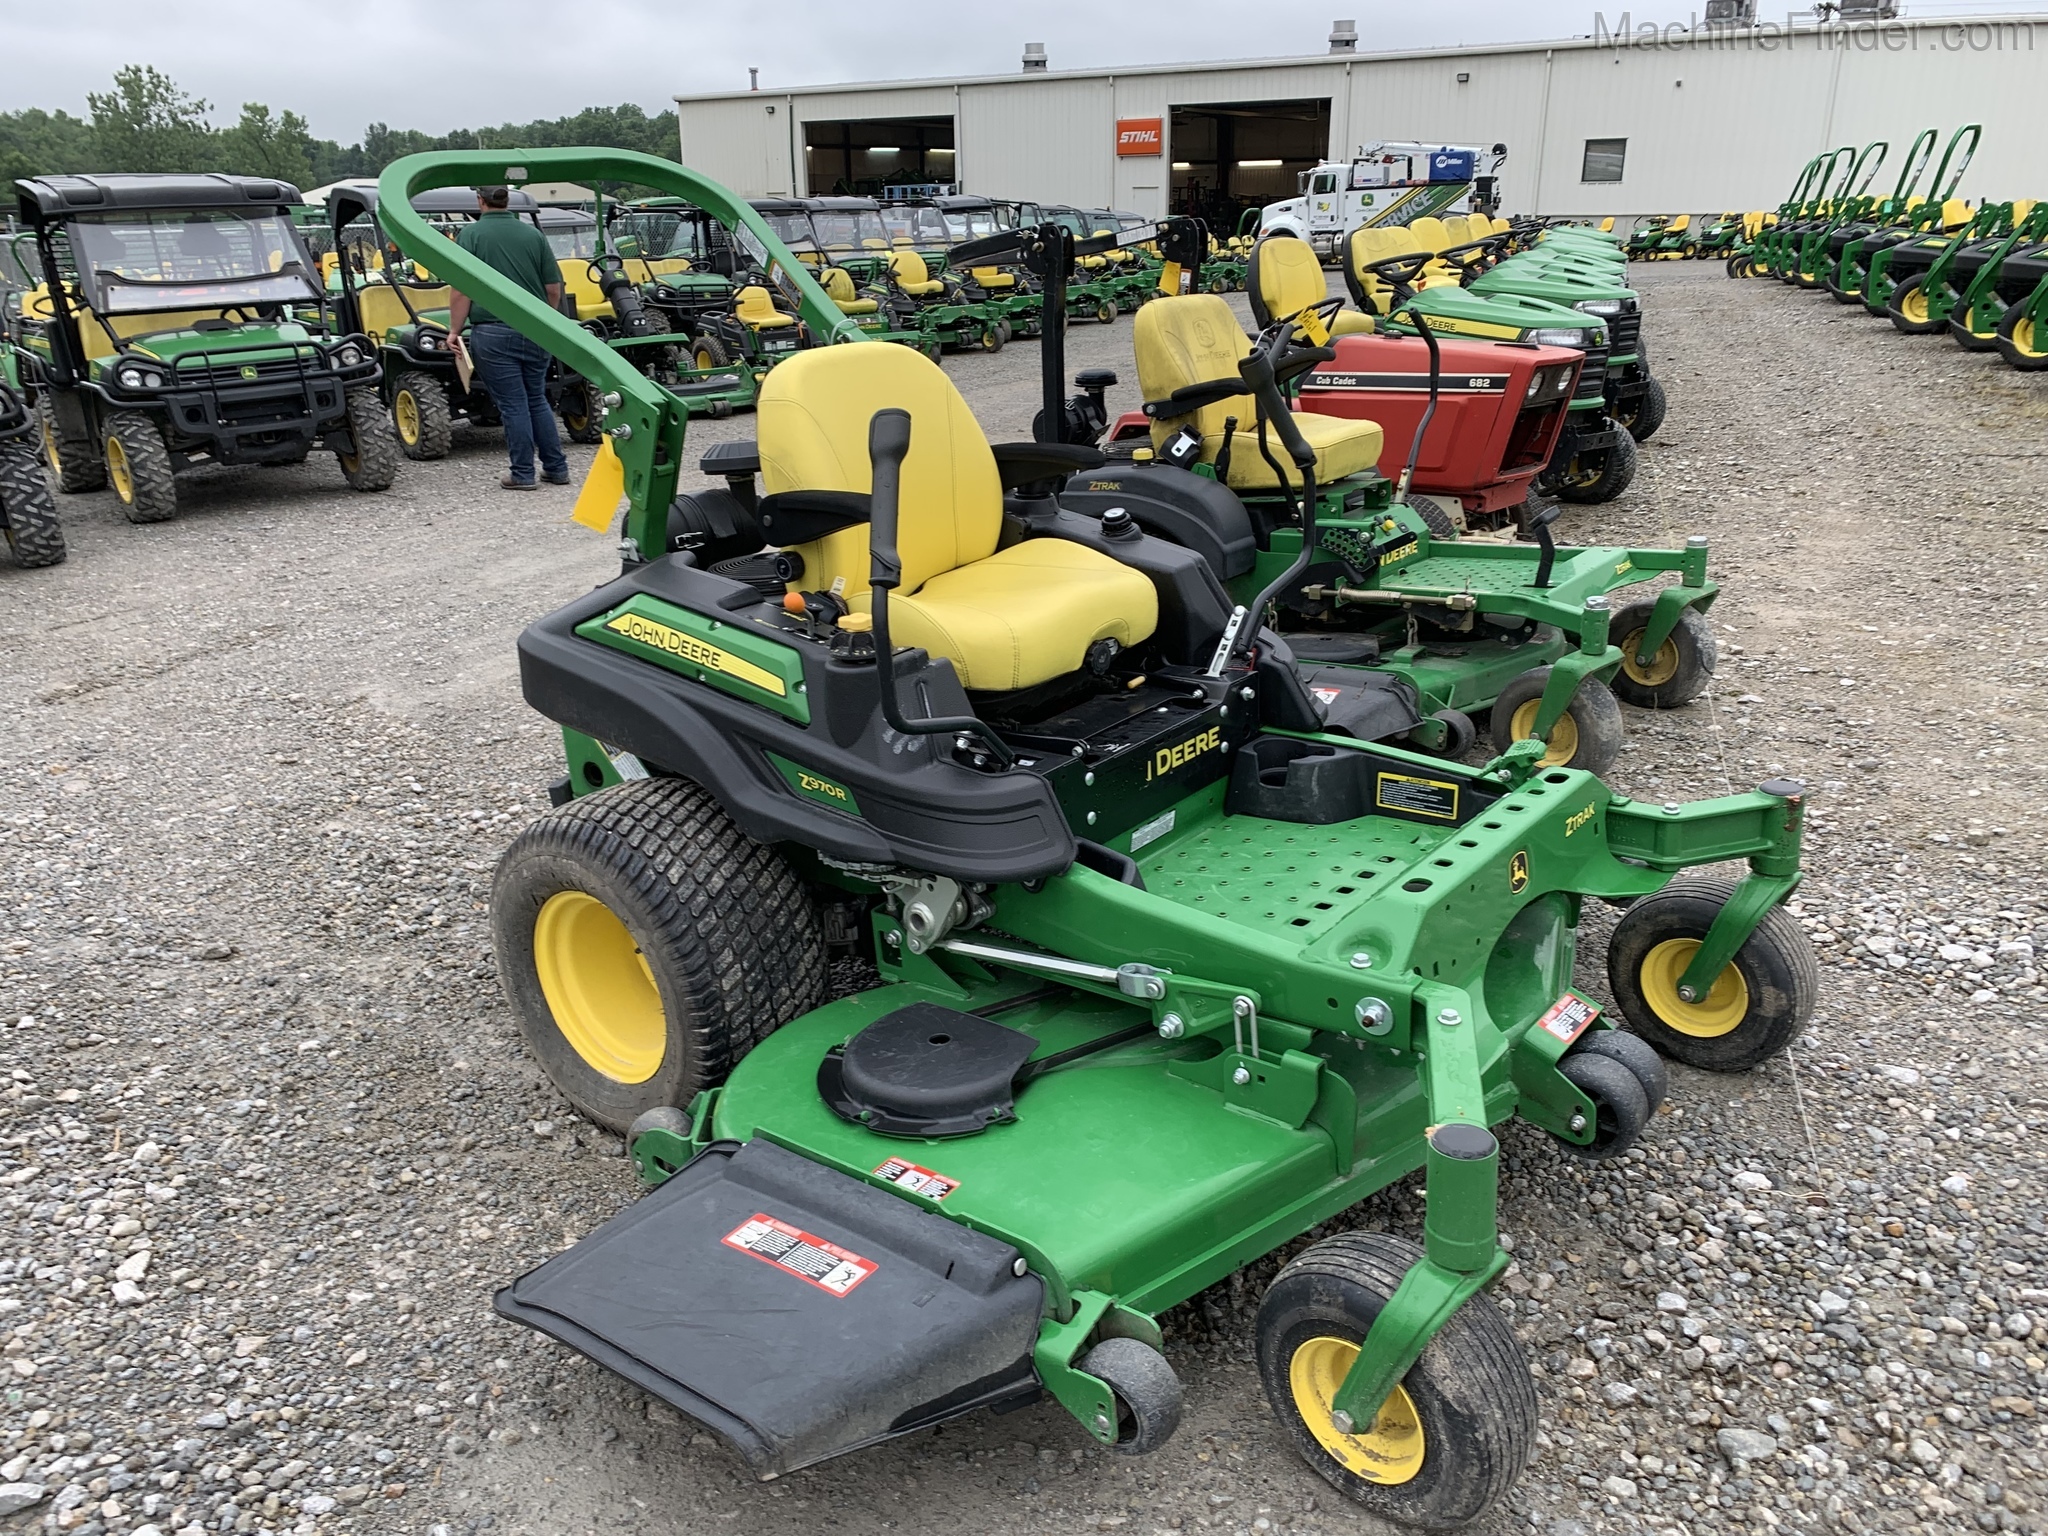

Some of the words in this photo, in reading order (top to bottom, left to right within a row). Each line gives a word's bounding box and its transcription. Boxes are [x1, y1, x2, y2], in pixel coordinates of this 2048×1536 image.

[1119, 130, 1158, 143] STIHL
[1426, 317, 1456, 331] DEERE
[1316, 376, 1331, 385] Cub
[1332, 376, 1357, 386] Cadet
[1469, 378, 1491, 388] 682
[623, 617, 666, 647] JOHN
[668, 631, 721, 668] DEERE
[1156, 726, 1220, 776] DEERE
[798, 772, 847, 801] Z970R
[1565, 801, 1595, 838] ZTRAK
